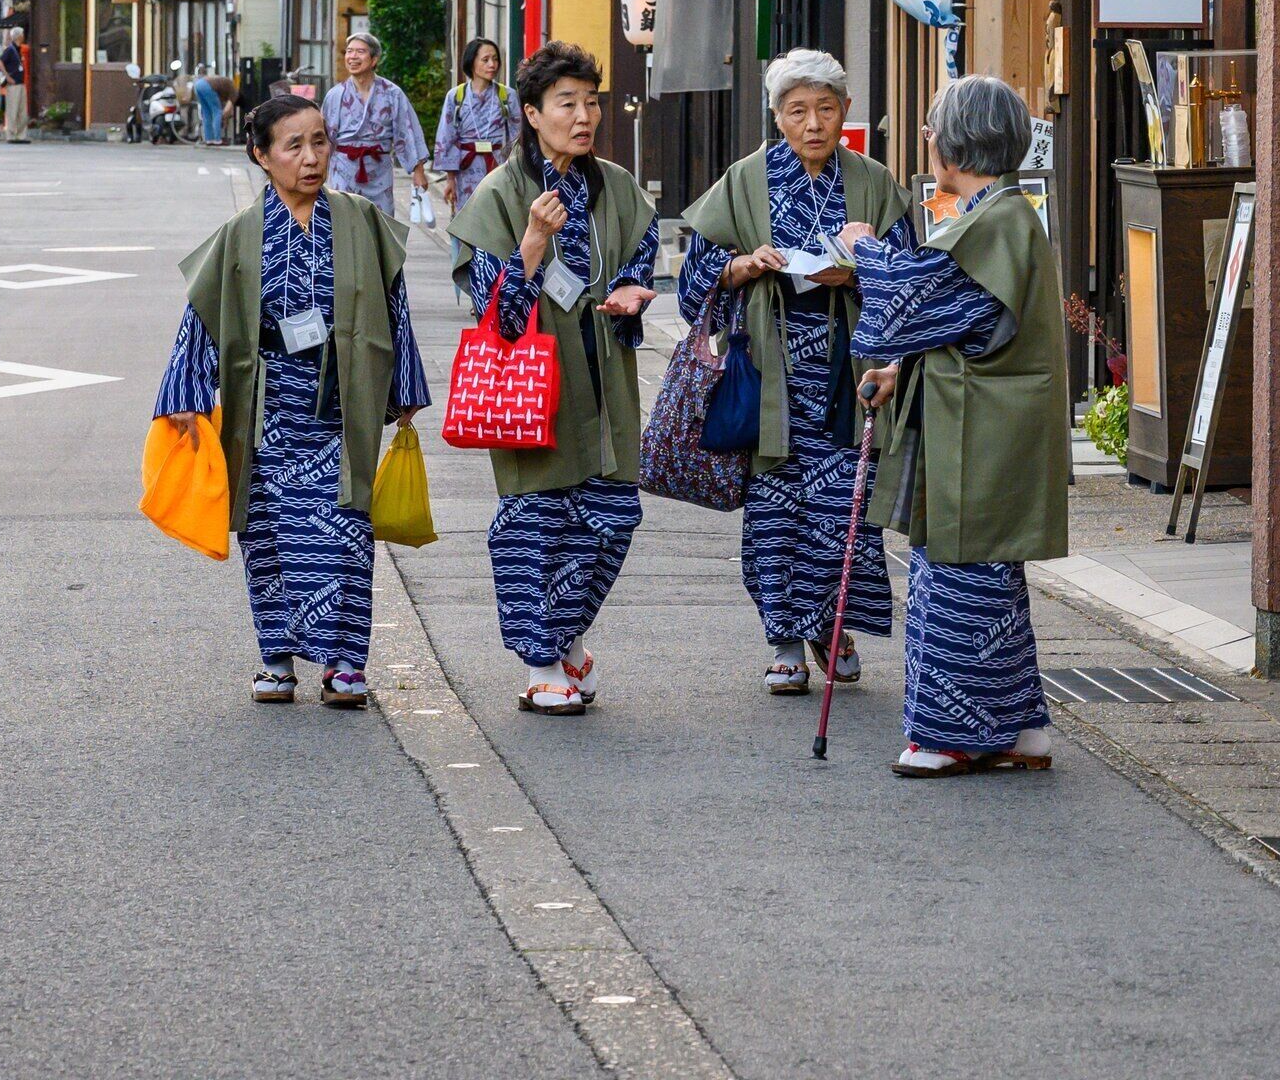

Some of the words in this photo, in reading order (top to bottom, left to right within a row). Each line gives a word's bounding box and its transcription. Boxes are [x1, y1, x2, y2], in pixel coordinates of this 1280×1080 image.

[883, 282, 917, 321] 川口屋
[934, 692, 981, 730] 川口屋
